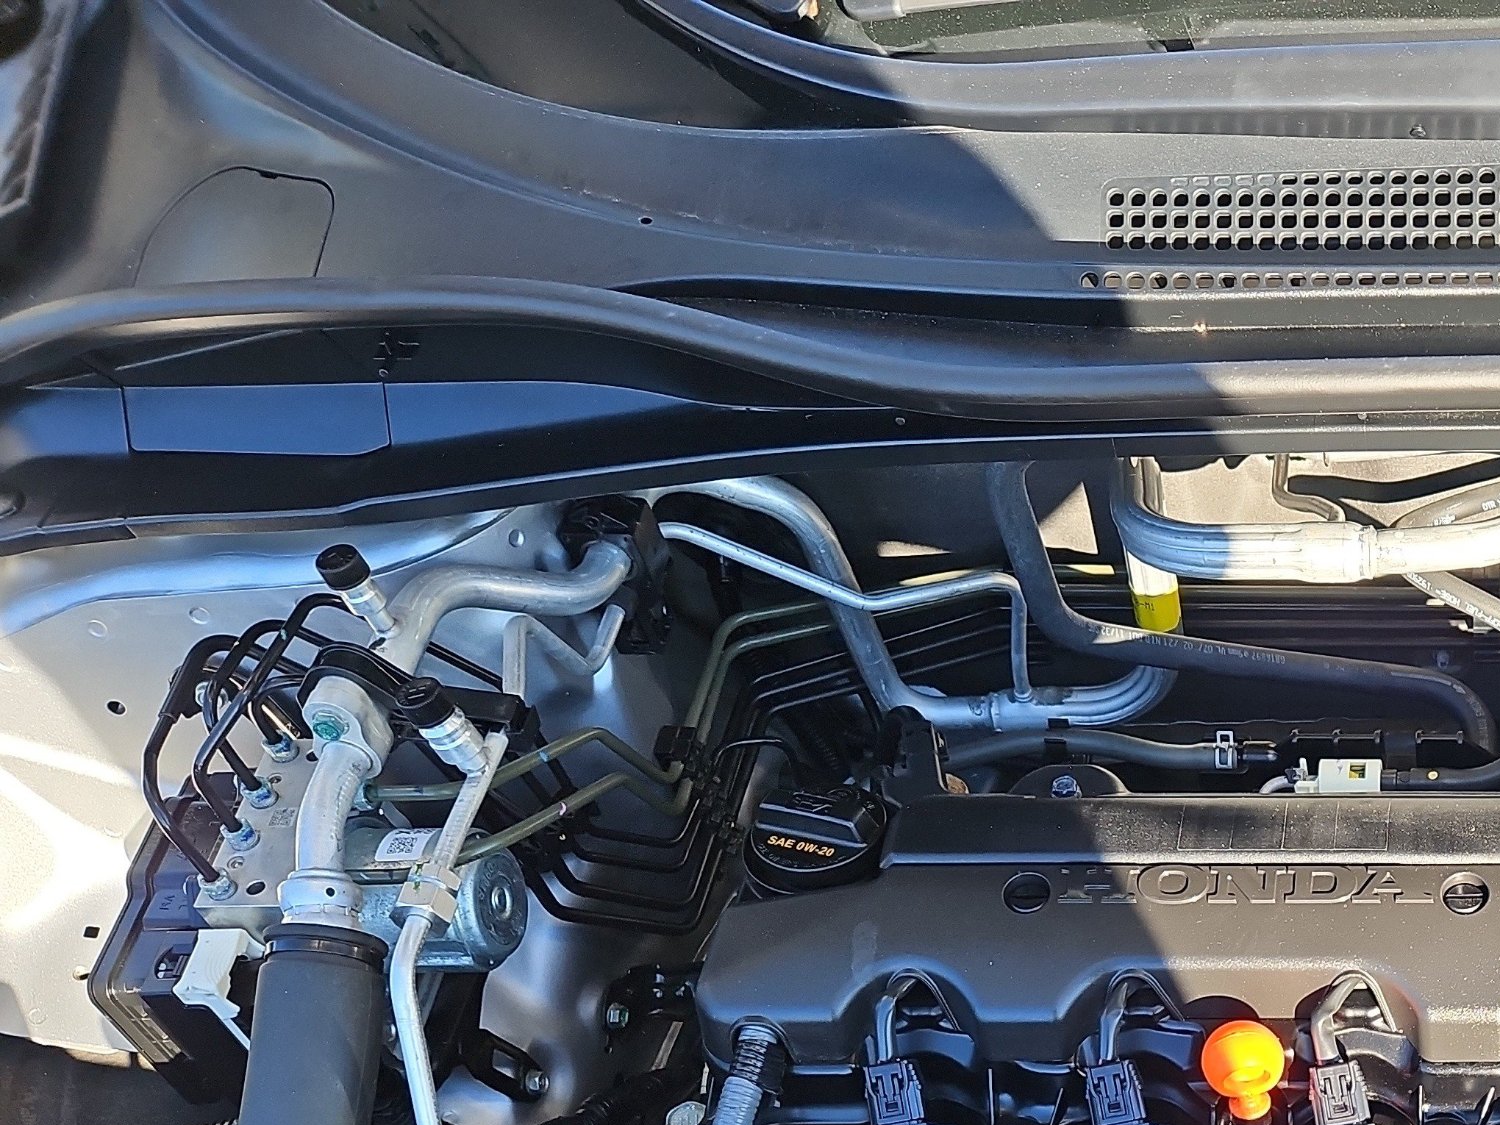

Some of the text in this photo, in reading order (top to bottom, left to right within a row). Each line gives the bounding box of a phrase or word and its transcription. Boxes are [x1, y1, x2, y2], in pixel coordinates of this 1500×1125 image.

[766, 834, 795, 849] SAE
[795, 841, 834, 857] 0W-20
[1057, 864, 1435, 904] HONDA
